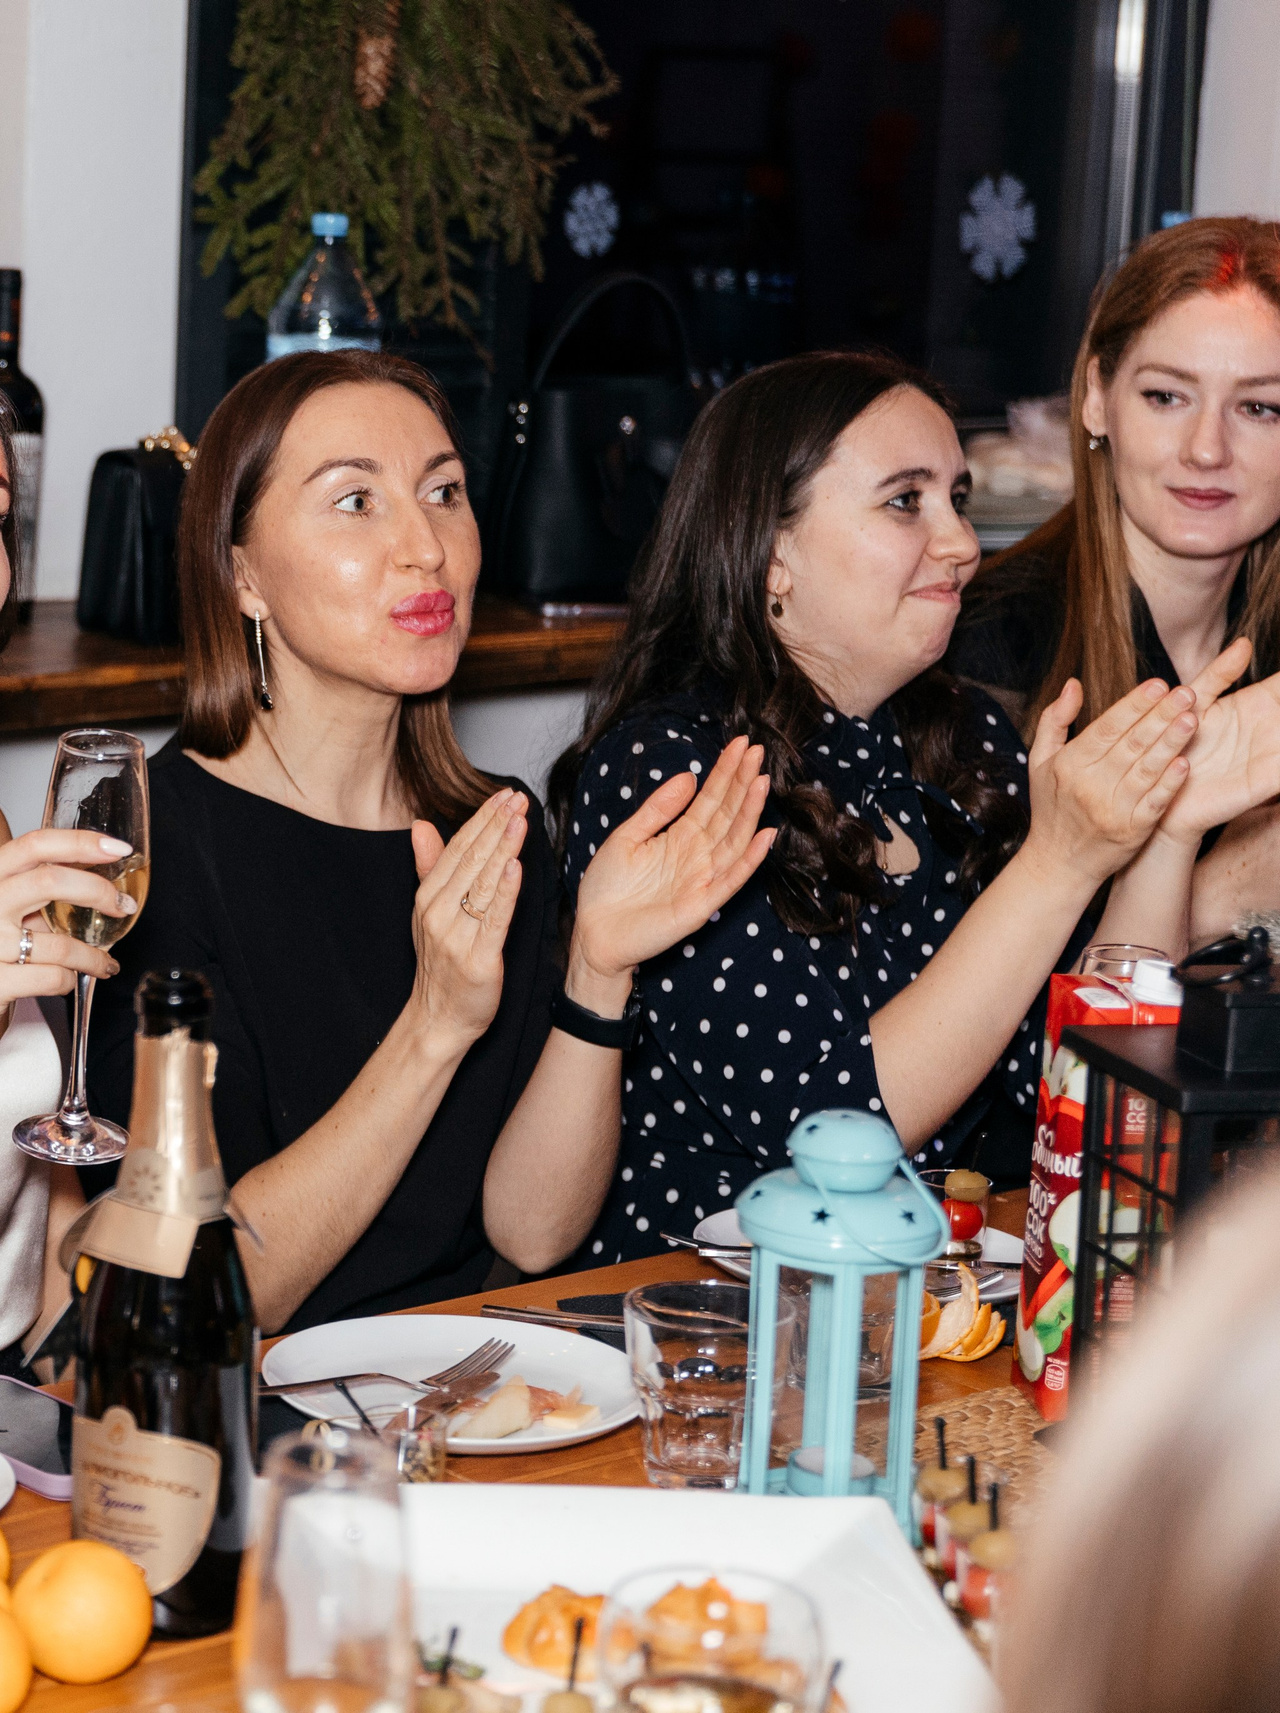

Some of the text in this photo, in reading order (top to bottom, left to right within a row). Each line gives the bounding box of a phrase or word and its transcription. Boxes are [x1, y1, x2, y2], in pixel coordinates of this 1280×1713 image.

[1032, 1124, 1084, 1178] обрый
[1029, 1179, 1057, 1217] 100%
[1026, 1207, 1046, 1243] СОК
